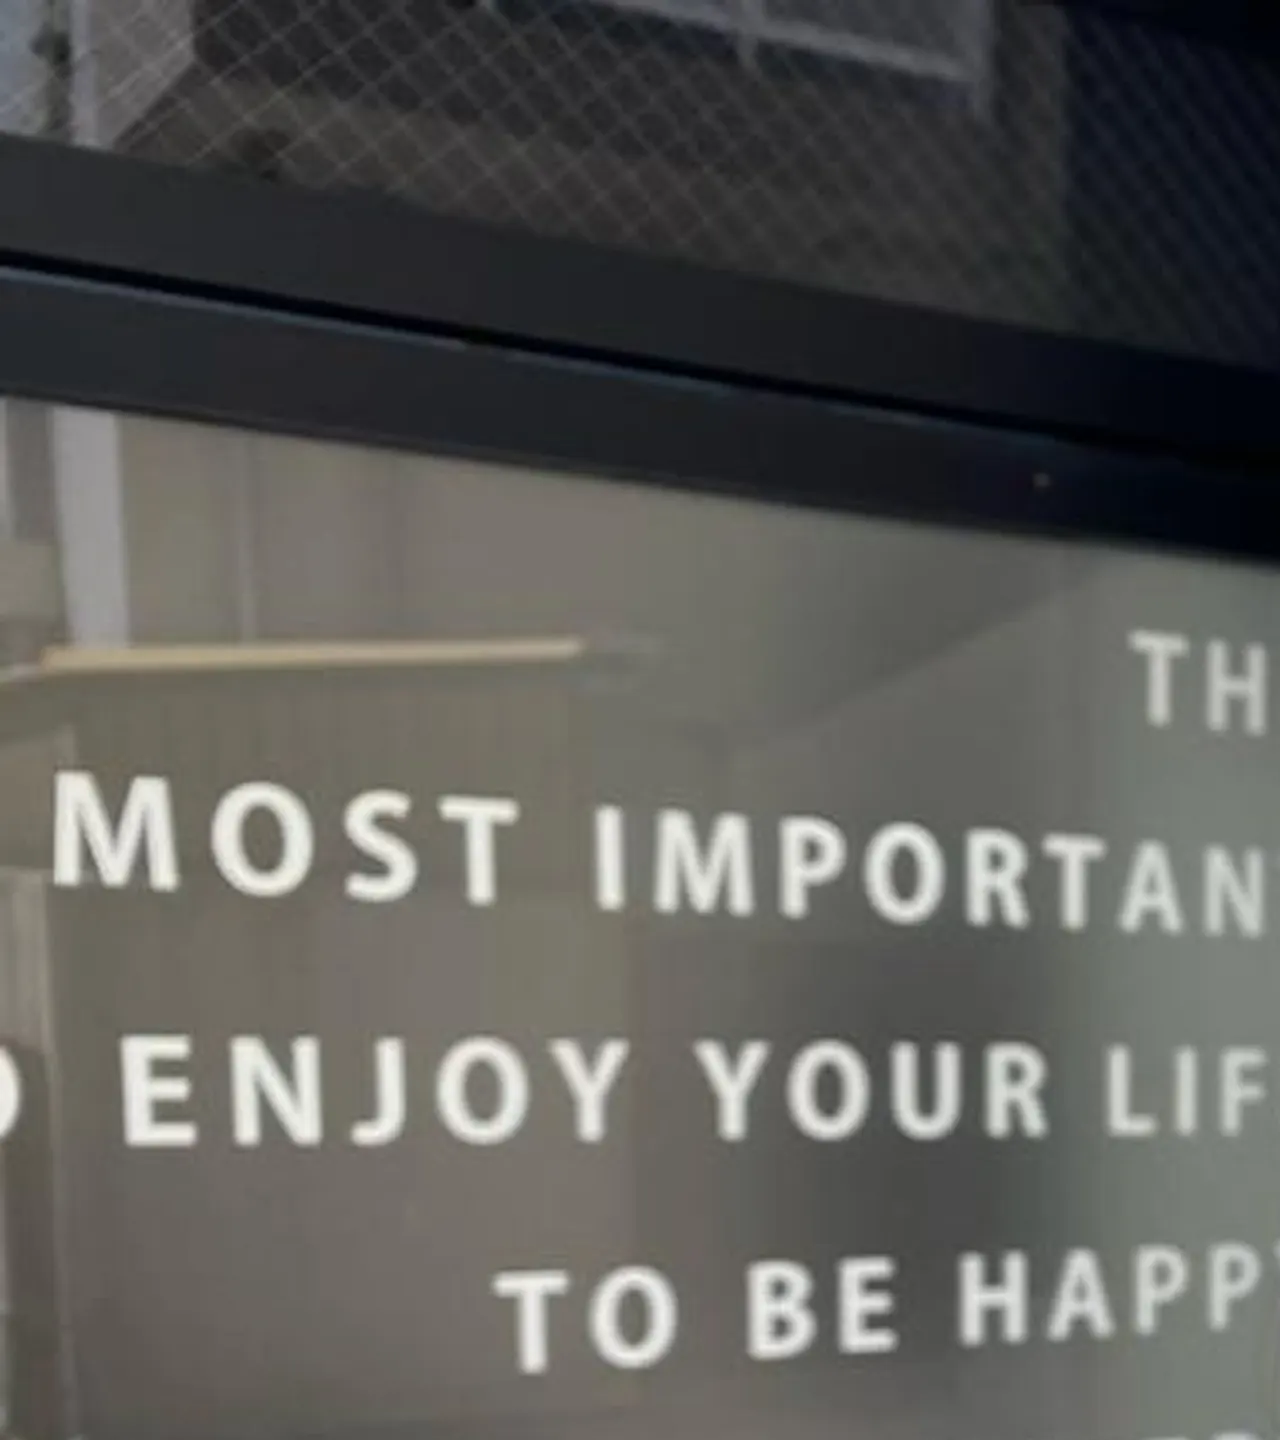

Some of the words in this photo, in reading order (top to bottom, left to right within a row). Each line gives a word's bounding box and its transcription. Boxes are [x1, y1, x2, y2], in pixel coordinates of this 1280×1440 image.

[53, 770, 519, 906] MOST
[120, 1034, 629, 1147] ENJOY
[694, 1039, 1047, 1141] YOUR
[492, 1266, 677, 1373] TO
[747, 1256, 897, 1360] BE
